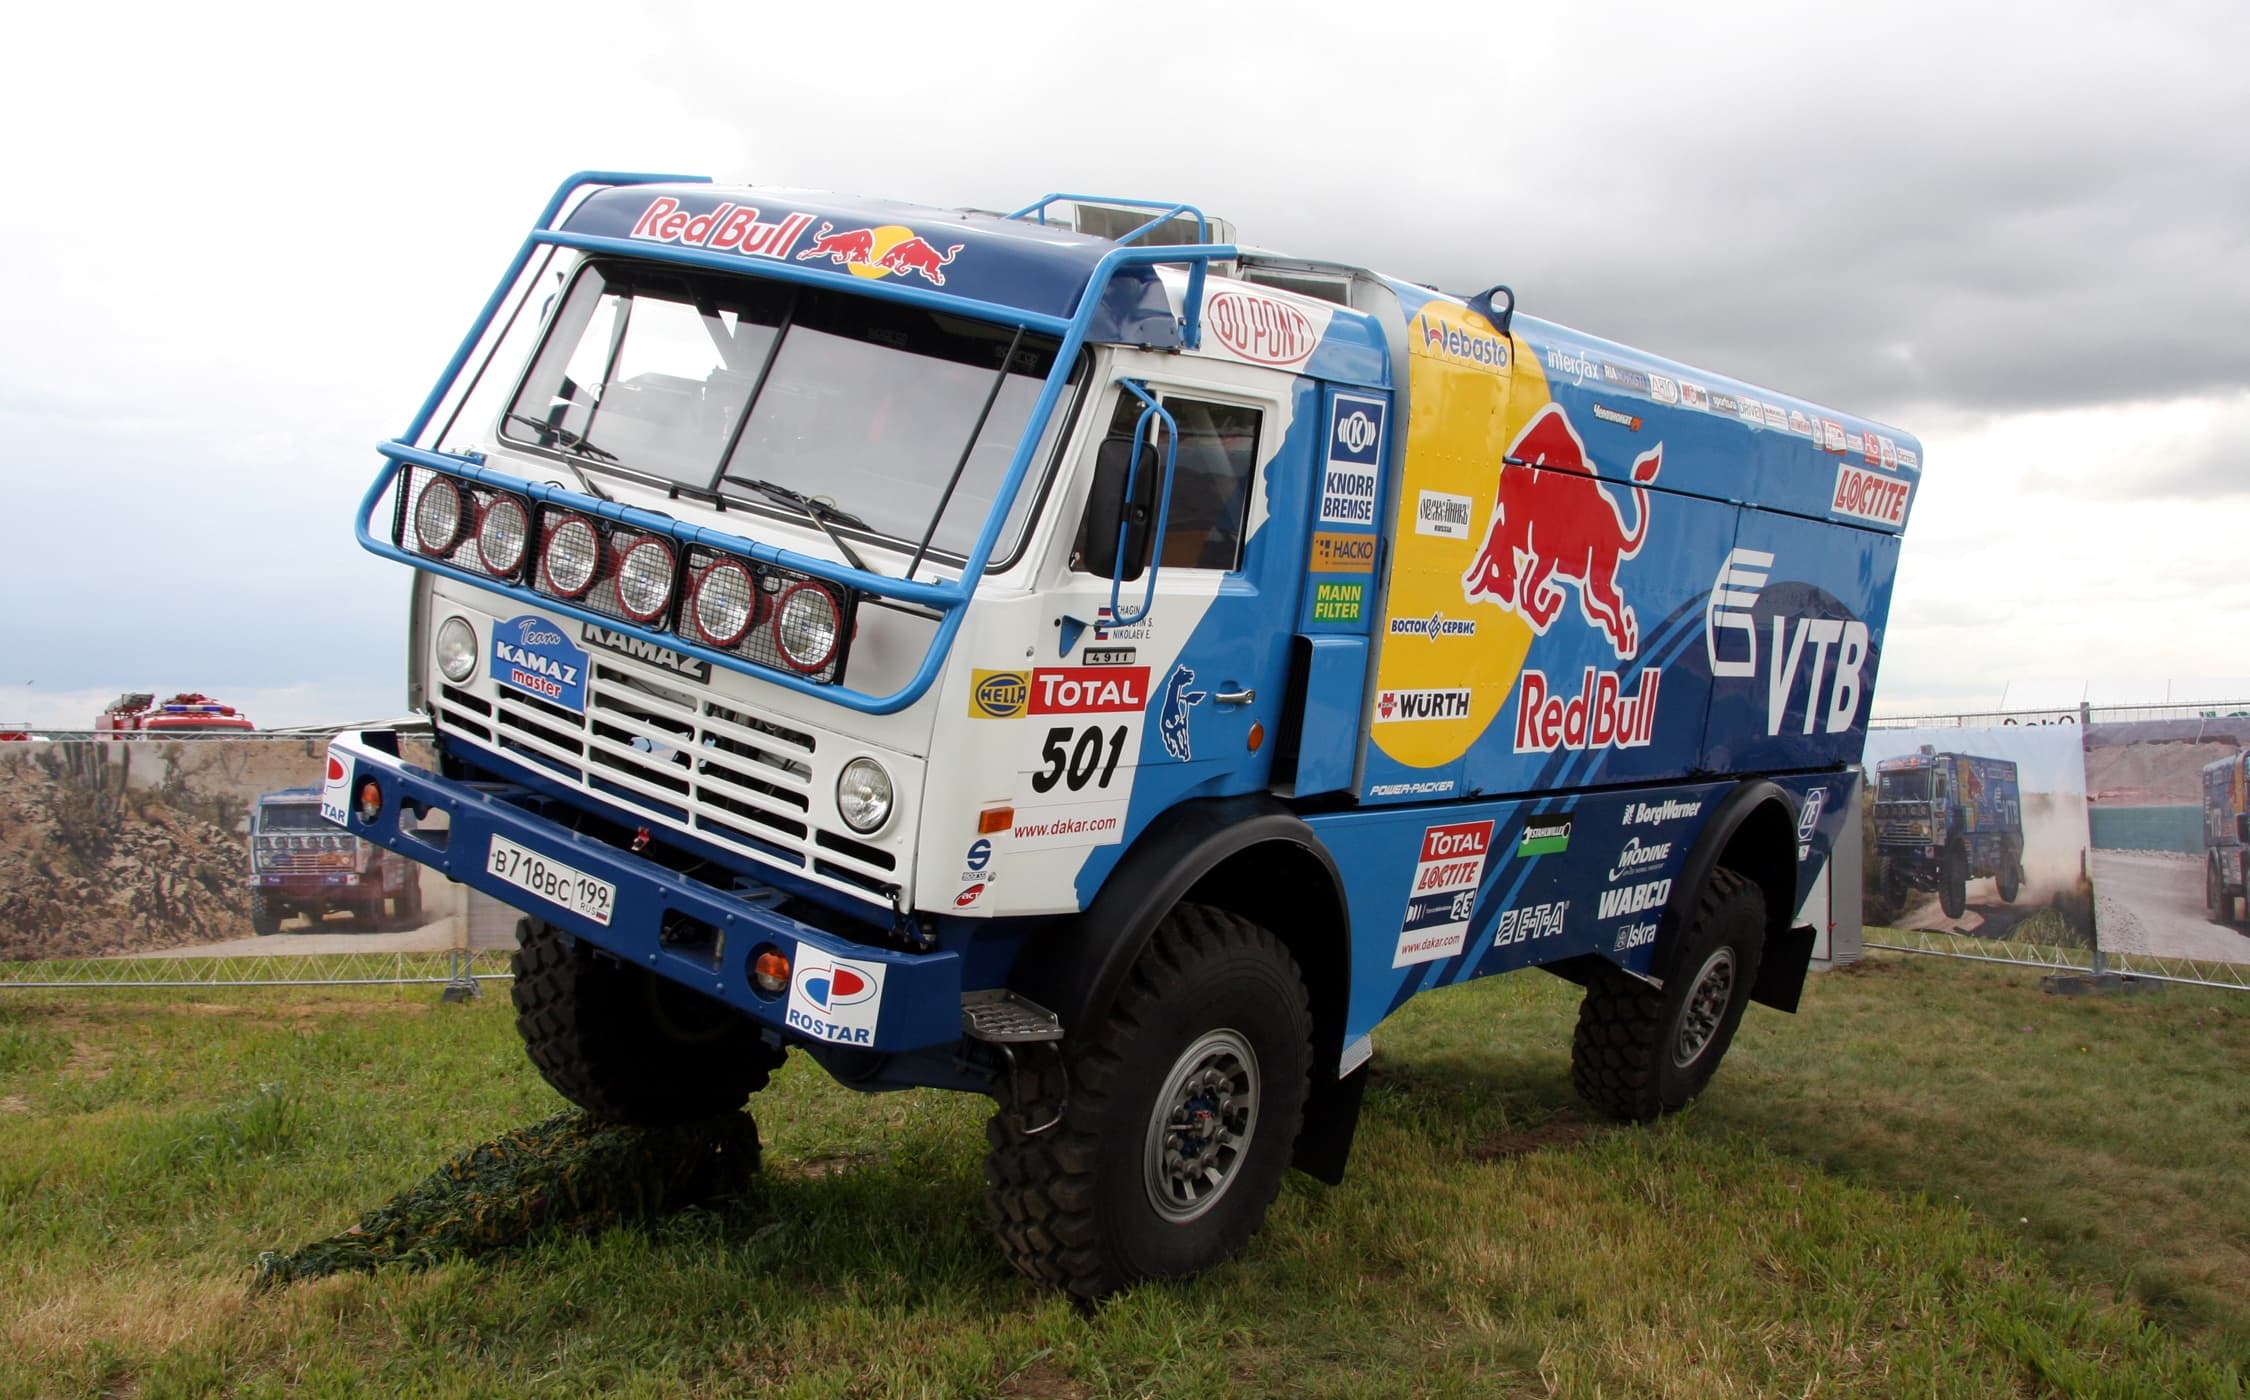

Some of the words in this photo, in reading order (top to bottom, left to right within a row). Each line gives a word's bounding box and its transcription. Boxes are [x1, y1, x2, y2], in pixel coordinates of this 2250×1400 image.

[1420, 314, 1508, 368] Webasto
[1326, 472, 1375, 498] KNORR
[1834, 470, 1908, 521] LOCTITE
[1323, 497, 1373, 520] BREMSE
[1333, 540, 1373, 559] HACKO
[1318, 585, 1361, 601] MANN
[1315, 603, 1359, 618] FILTER
[519, 619, 561, 646] Team
[1112, 630, 1144, 640] NIKOLAEV
[1391, 619, 1427, 633] ВОСТОК
[1442, 621, 1475, 634] СЕРВИС
[496, 641, 578, 686] KAMAZ
[585, 624, 702, 677] KAMAZ
[512, 668, 561, 698] master
[1768, 615, 1868, 736] VTB
[981, 686, 1026, 704] HELLA
[1400, 693, 1470, 718] WÜRTH
[1032, 725, 1128, 793] 501
[1370, 781, 1454, 796] POWER-PACKER
[1635, 800, 1701, 826] BorgWarner
[1014, 817, 1117, 839] www.dakar.com
[1619, 842, 1672, 868] MODINE
[1417, 861, 1479, 890] LOCTITE
[577, 878, 608, 909] 199
[1598, 879, 1672, 920] WABCO
[580, 902, 596, 916] RUS
[1402, 934, 1460, 954] www.dakar.com
[1626, 922, 1656, 949] Iskra
[789, 1008, 870, 1044] ROSTAR
